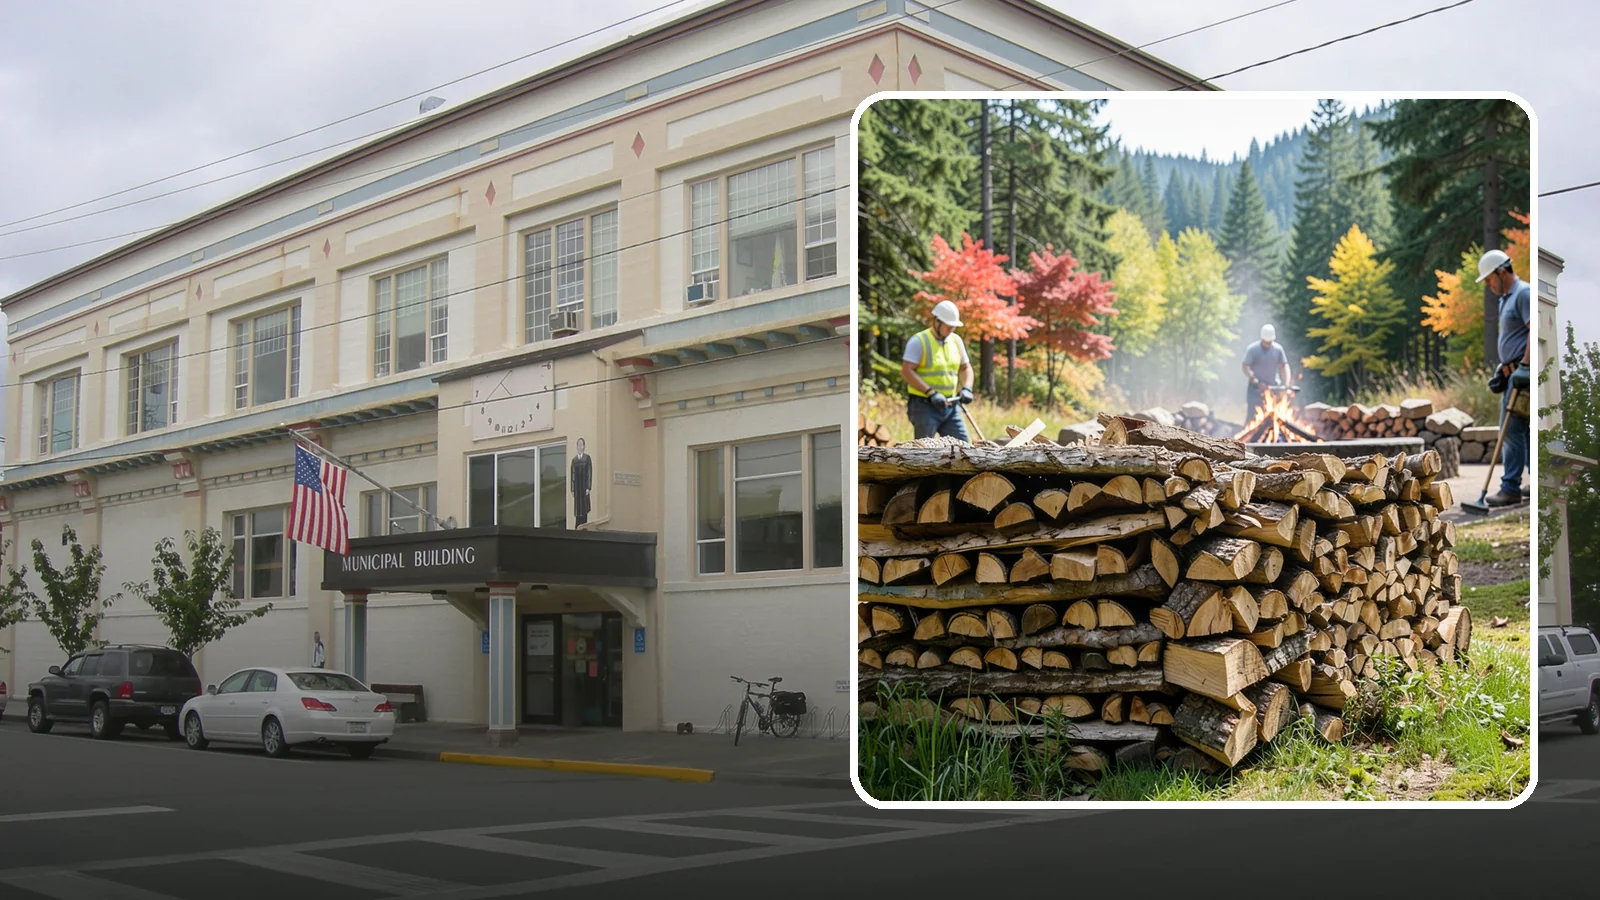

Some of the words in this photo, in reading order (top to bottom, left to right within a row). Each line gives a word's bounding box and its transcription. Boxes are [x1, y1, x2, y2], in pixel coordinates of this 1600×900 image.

[536, 402, 540, 410] 4
[528, 413, 533, 422] 3
[487, 417, 493, 426] 9
[507, 425, 513, 433] 12
[521, 420, 526, 428] 2
[342, 552, 405, 571] MUNICIPAL
[414, 546, 475, 567] BUILDING
